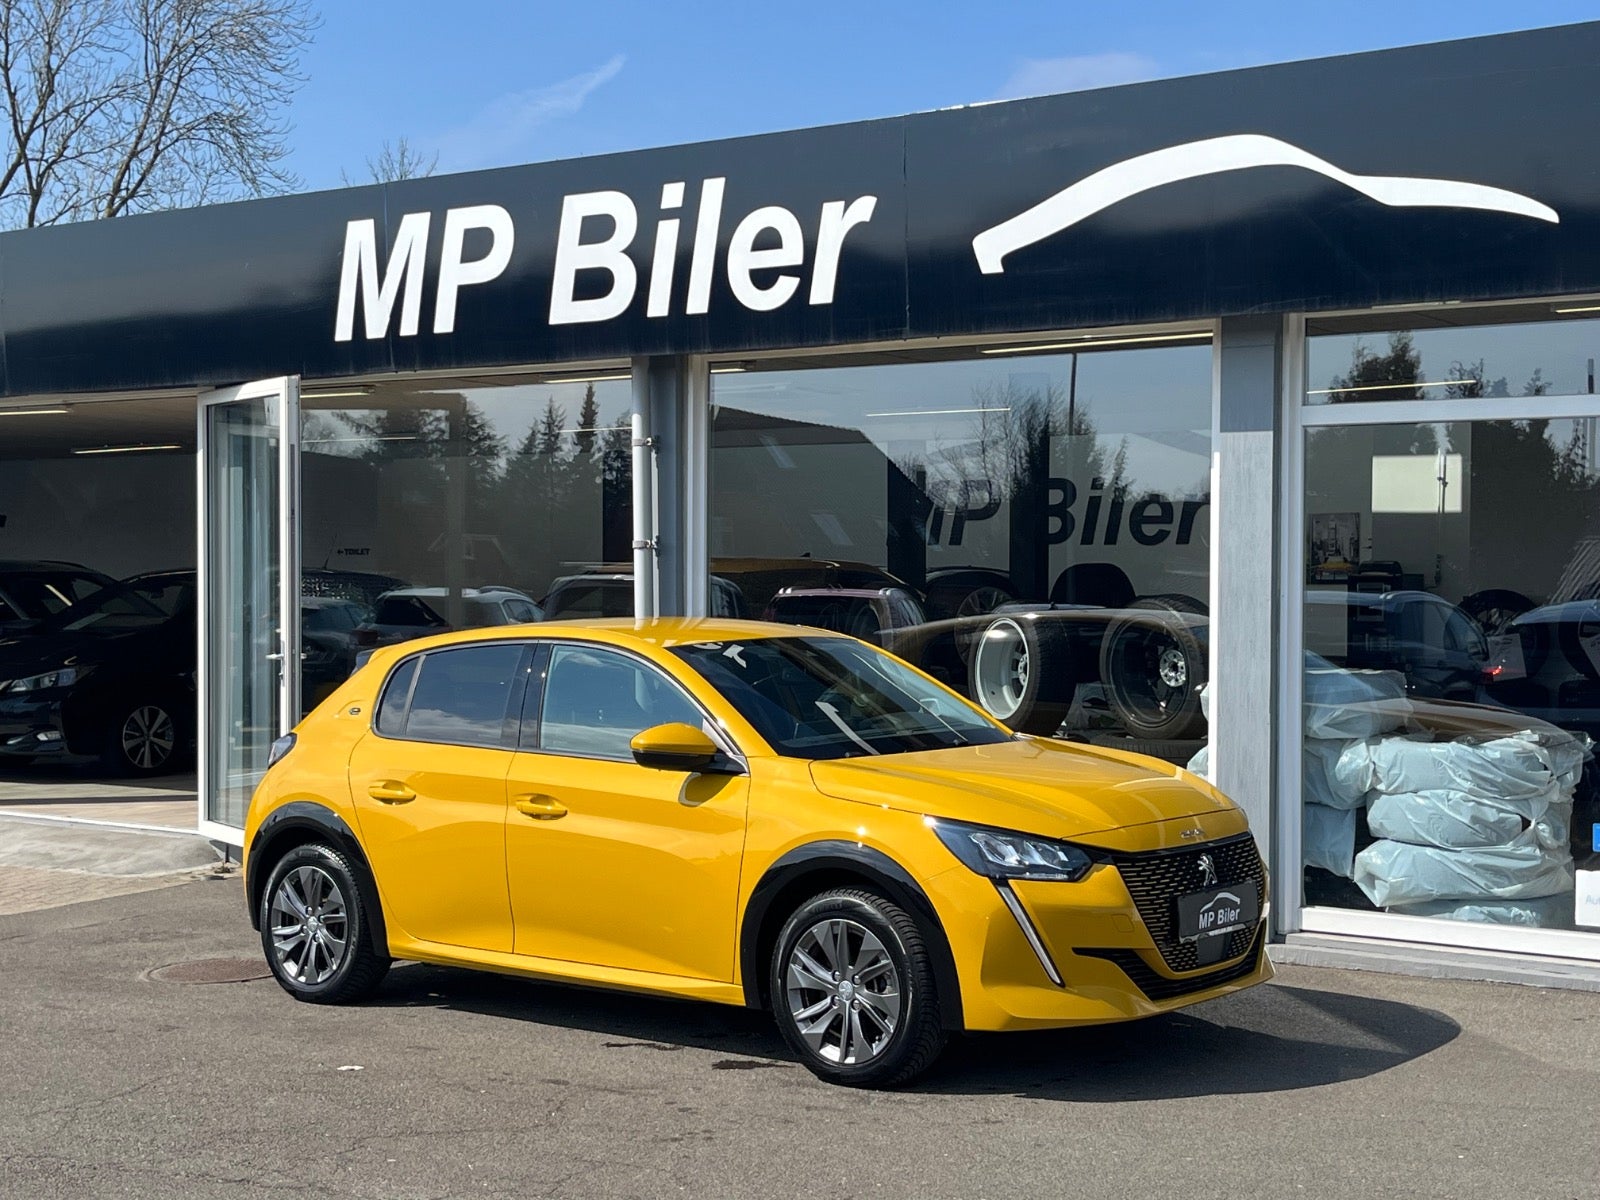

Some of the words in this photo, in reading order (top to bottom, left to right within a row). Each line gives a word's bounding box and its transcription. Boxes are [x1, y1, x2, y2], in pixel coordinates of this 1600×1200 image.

[334, 204, 515, 342] MP
[548, 177, 878, 325] Biler
[1199, 911, 1215, 930] MP
[1217, 907, 1240, 924] Biler
